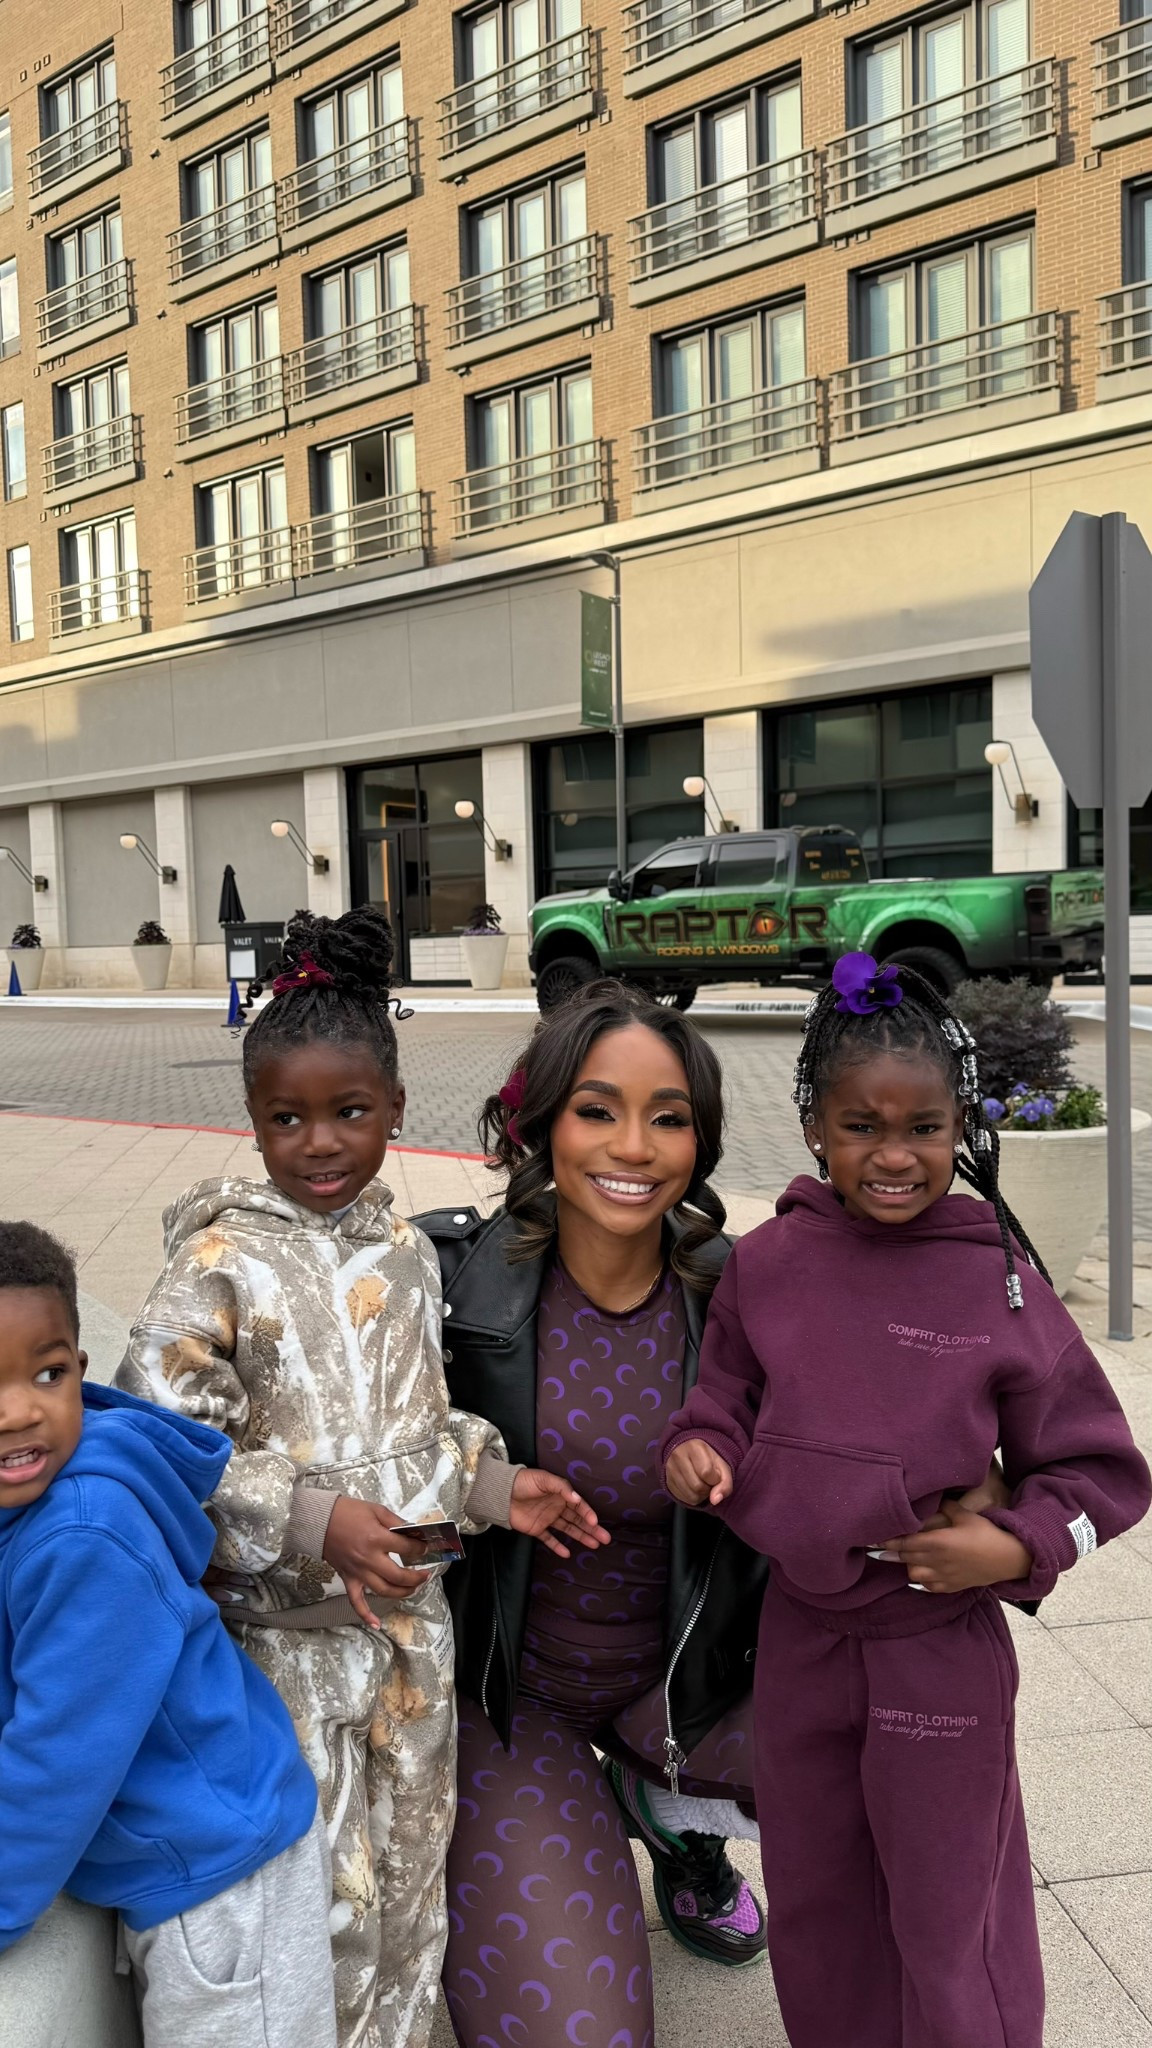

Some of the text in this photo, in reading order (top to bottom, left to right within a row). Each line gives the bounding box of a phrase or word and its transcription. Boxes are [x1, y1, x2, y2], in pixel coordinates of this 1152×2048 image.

[615, 903, 828, 956] RAPTOR
[233, 937, 252, 946] VALET
[656, 943, 779, 956] ROOFING & WINDOWS
[769, 1003, 806, 1012] PARKIN
[887, 1323, 991, 1345] COMFRT CLOTHING
[897, 1337, 914, 1347] take
[928, 1344, 944, 1357] of
[1081, 1518, 1094, 1553] gratitu
[869, 1706, 978, 1727] COMFRT CLOTHING
[880, 1721, 966, 1741] take care of your mind
